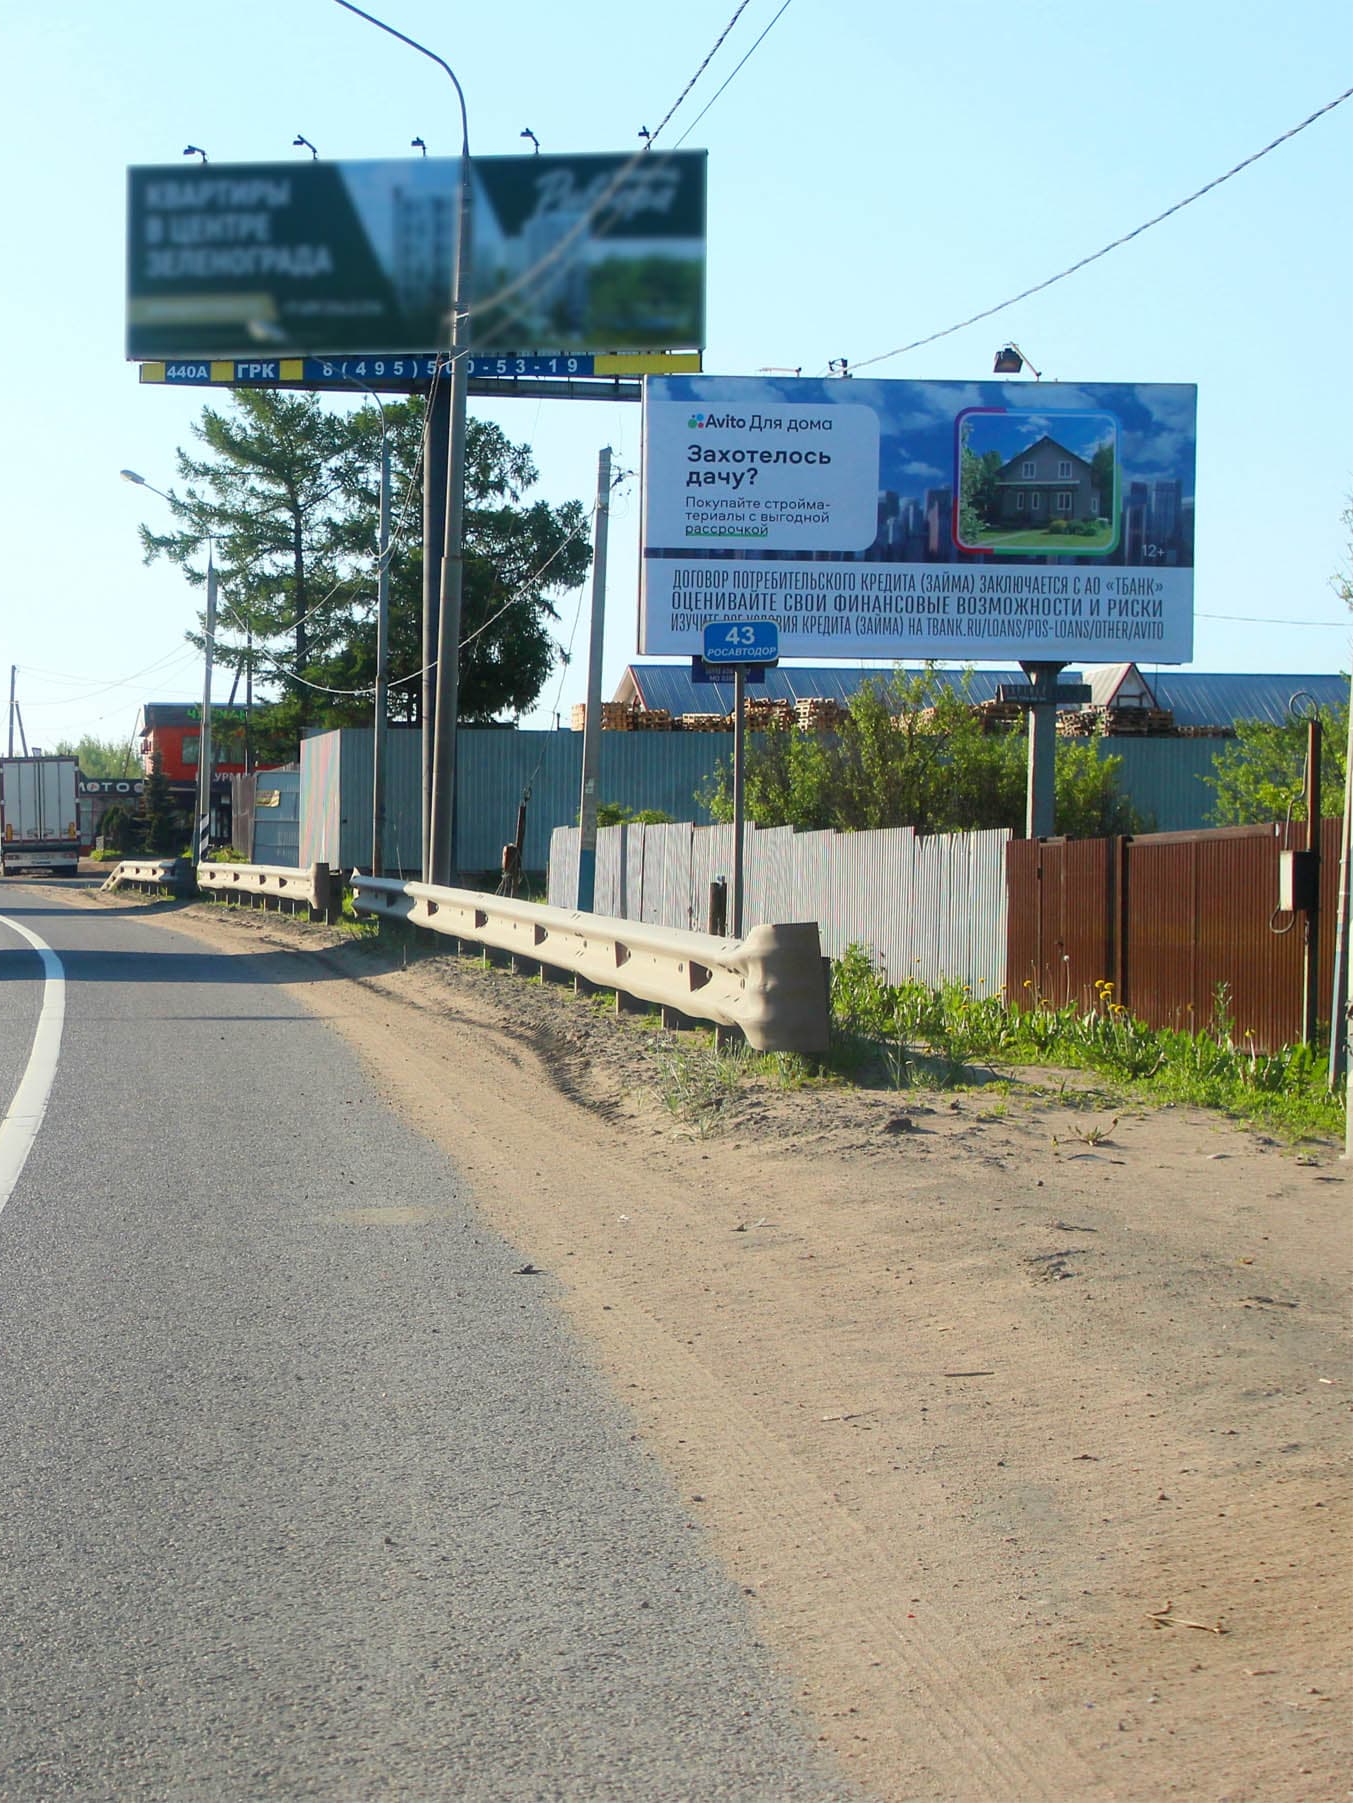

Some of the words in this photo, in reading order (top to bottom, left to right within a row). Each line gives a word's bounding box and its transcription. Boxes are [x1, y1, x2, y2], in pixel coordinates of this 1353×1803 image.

[145, 179, 291, 207] КВАРТИРЫ
[170, 212, 270, 244] ЦЕНТРЕ
[146, 245, 333, 278] ЗЕЛЕНОГРАДА
[237, 363, 275, 378] ГРК
[705, 413, 746, 429] Avito
[749, 414, 782, 432] Для
[786, 419, 833, 432] дома
[687, 444, 832, 465] Захотелось
[686, 467, 758, 490] дачу?
[686, 496, 761, 512] Покупайте
[764, 498, 832, 512] стройма-
[686, 512, 745, 523] териалы
[749, 513, 757, 522] с
[761, 511, 830, 524] выгодной
[686, 524, 768, 536] рассрочкой
[1142, 543, 1165, 557] 12+
[672, 569, 729, 590] ДОГОВОР
[733, 570, 856, 592] ПОТРЕБИТЕЛЬСКОГО
[861, 574, 916, 594] КРЕДИТА
[921, 572, 975, 594] (ЗАЙМА)
[980, 575, 1068, 595] ЗАКЛЮЧАЕТСЯ
[1073, 577, 1080, 595] С
[1084, 577, 1100, 595] АО
[1106, 576, 1164, 596] «ТБАНК»
[671, 590, 777, 612] ОЦЕНИВАЙТЕ
[784, 594, 827, 612] СВОИ
[834, 594, 950, 615] ФИНАНСОВЫЕ
[956, 597, 1082, 617] ВОЗМОЖНОСТИ
[1089, 599, 1099, 616] И
[1108, 599, 1162, 618] РИСКИ
[802, 615, 850, 635] КРЕДИТА
[855, 613, 904, 636] (ЗАЙМА)
[908, 617, 923, 636] НА
[725, 626, 756, 645] 43
[708, 647, 777, 657] РОСАВТОДОР
